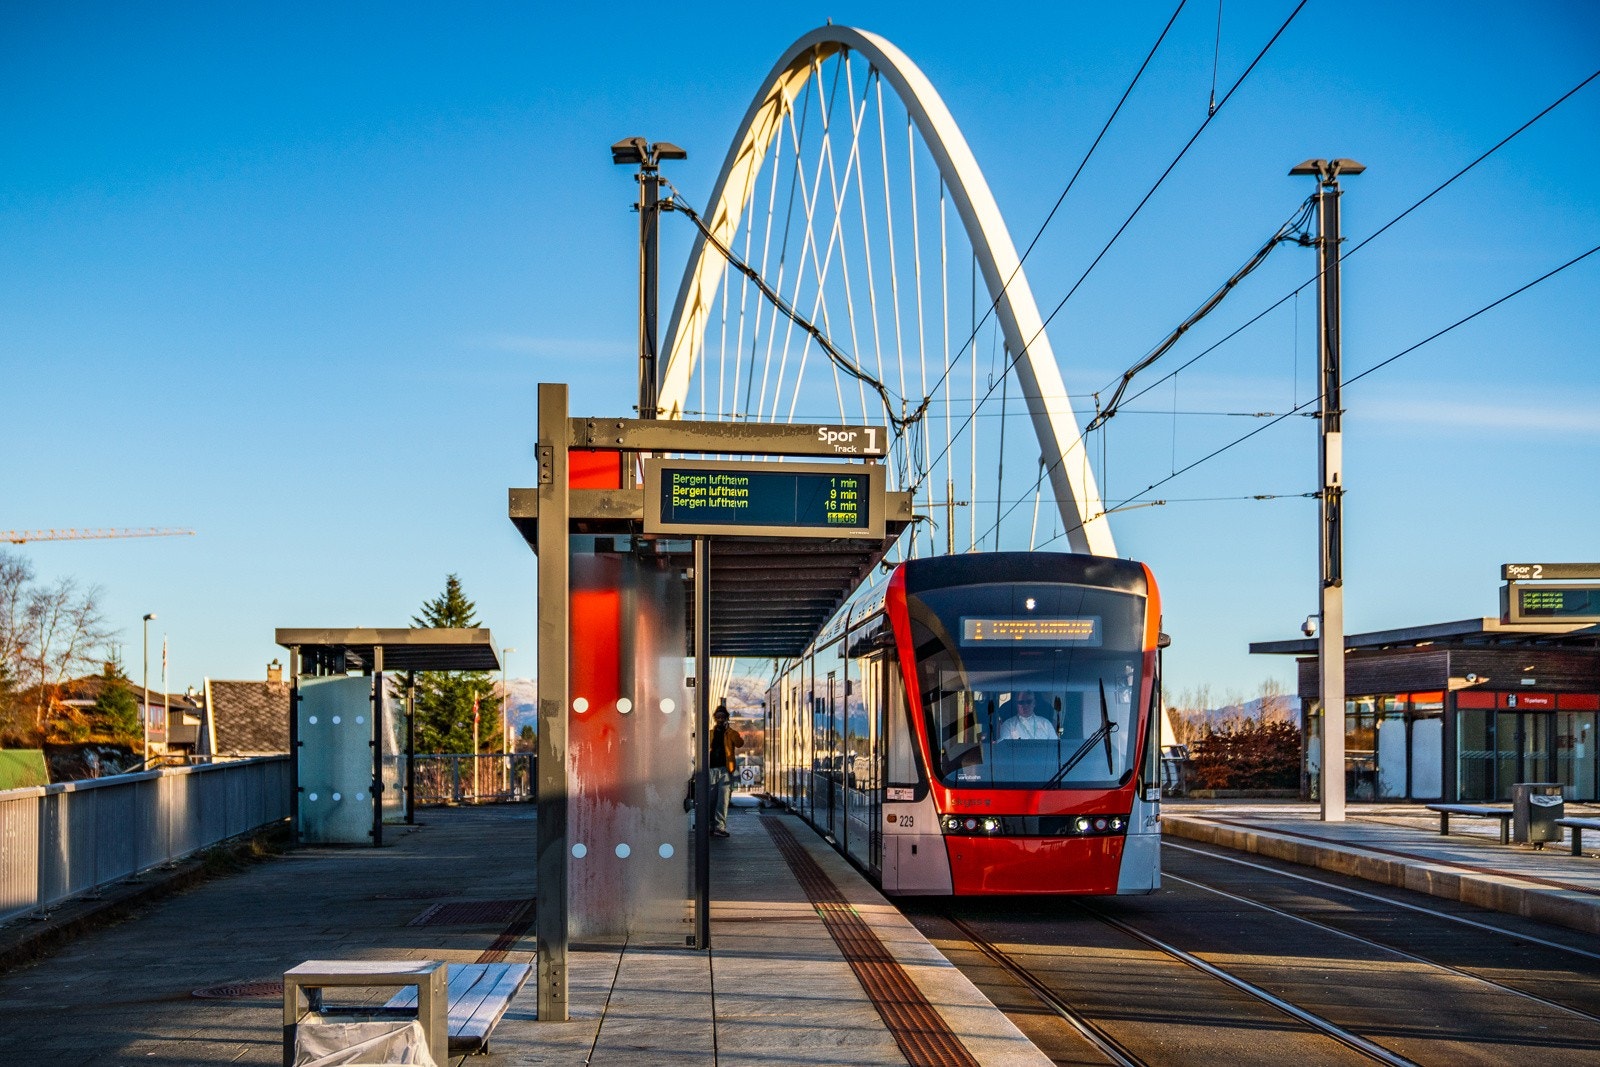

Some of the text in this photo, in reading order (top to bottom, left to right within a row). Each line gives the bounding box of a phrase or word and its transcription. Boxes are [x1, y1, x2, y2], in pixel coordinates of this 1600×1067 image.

[818, 427, 880, 454] Spor 1
[673, 474, 748, 485] Bergen lufthavn
[830, 478, 857, 488] 1 min
[673, 485, 748, 497] Bergen lufthavn
[830, 490, 857, 500] 9 min
[673, 496, 748, 508] Bergen lufthavn
[824, 500, 857, 510] 16 min
[1508, 564, 1542, 578] Spor 2
[900, 815, 914, 828] 229
